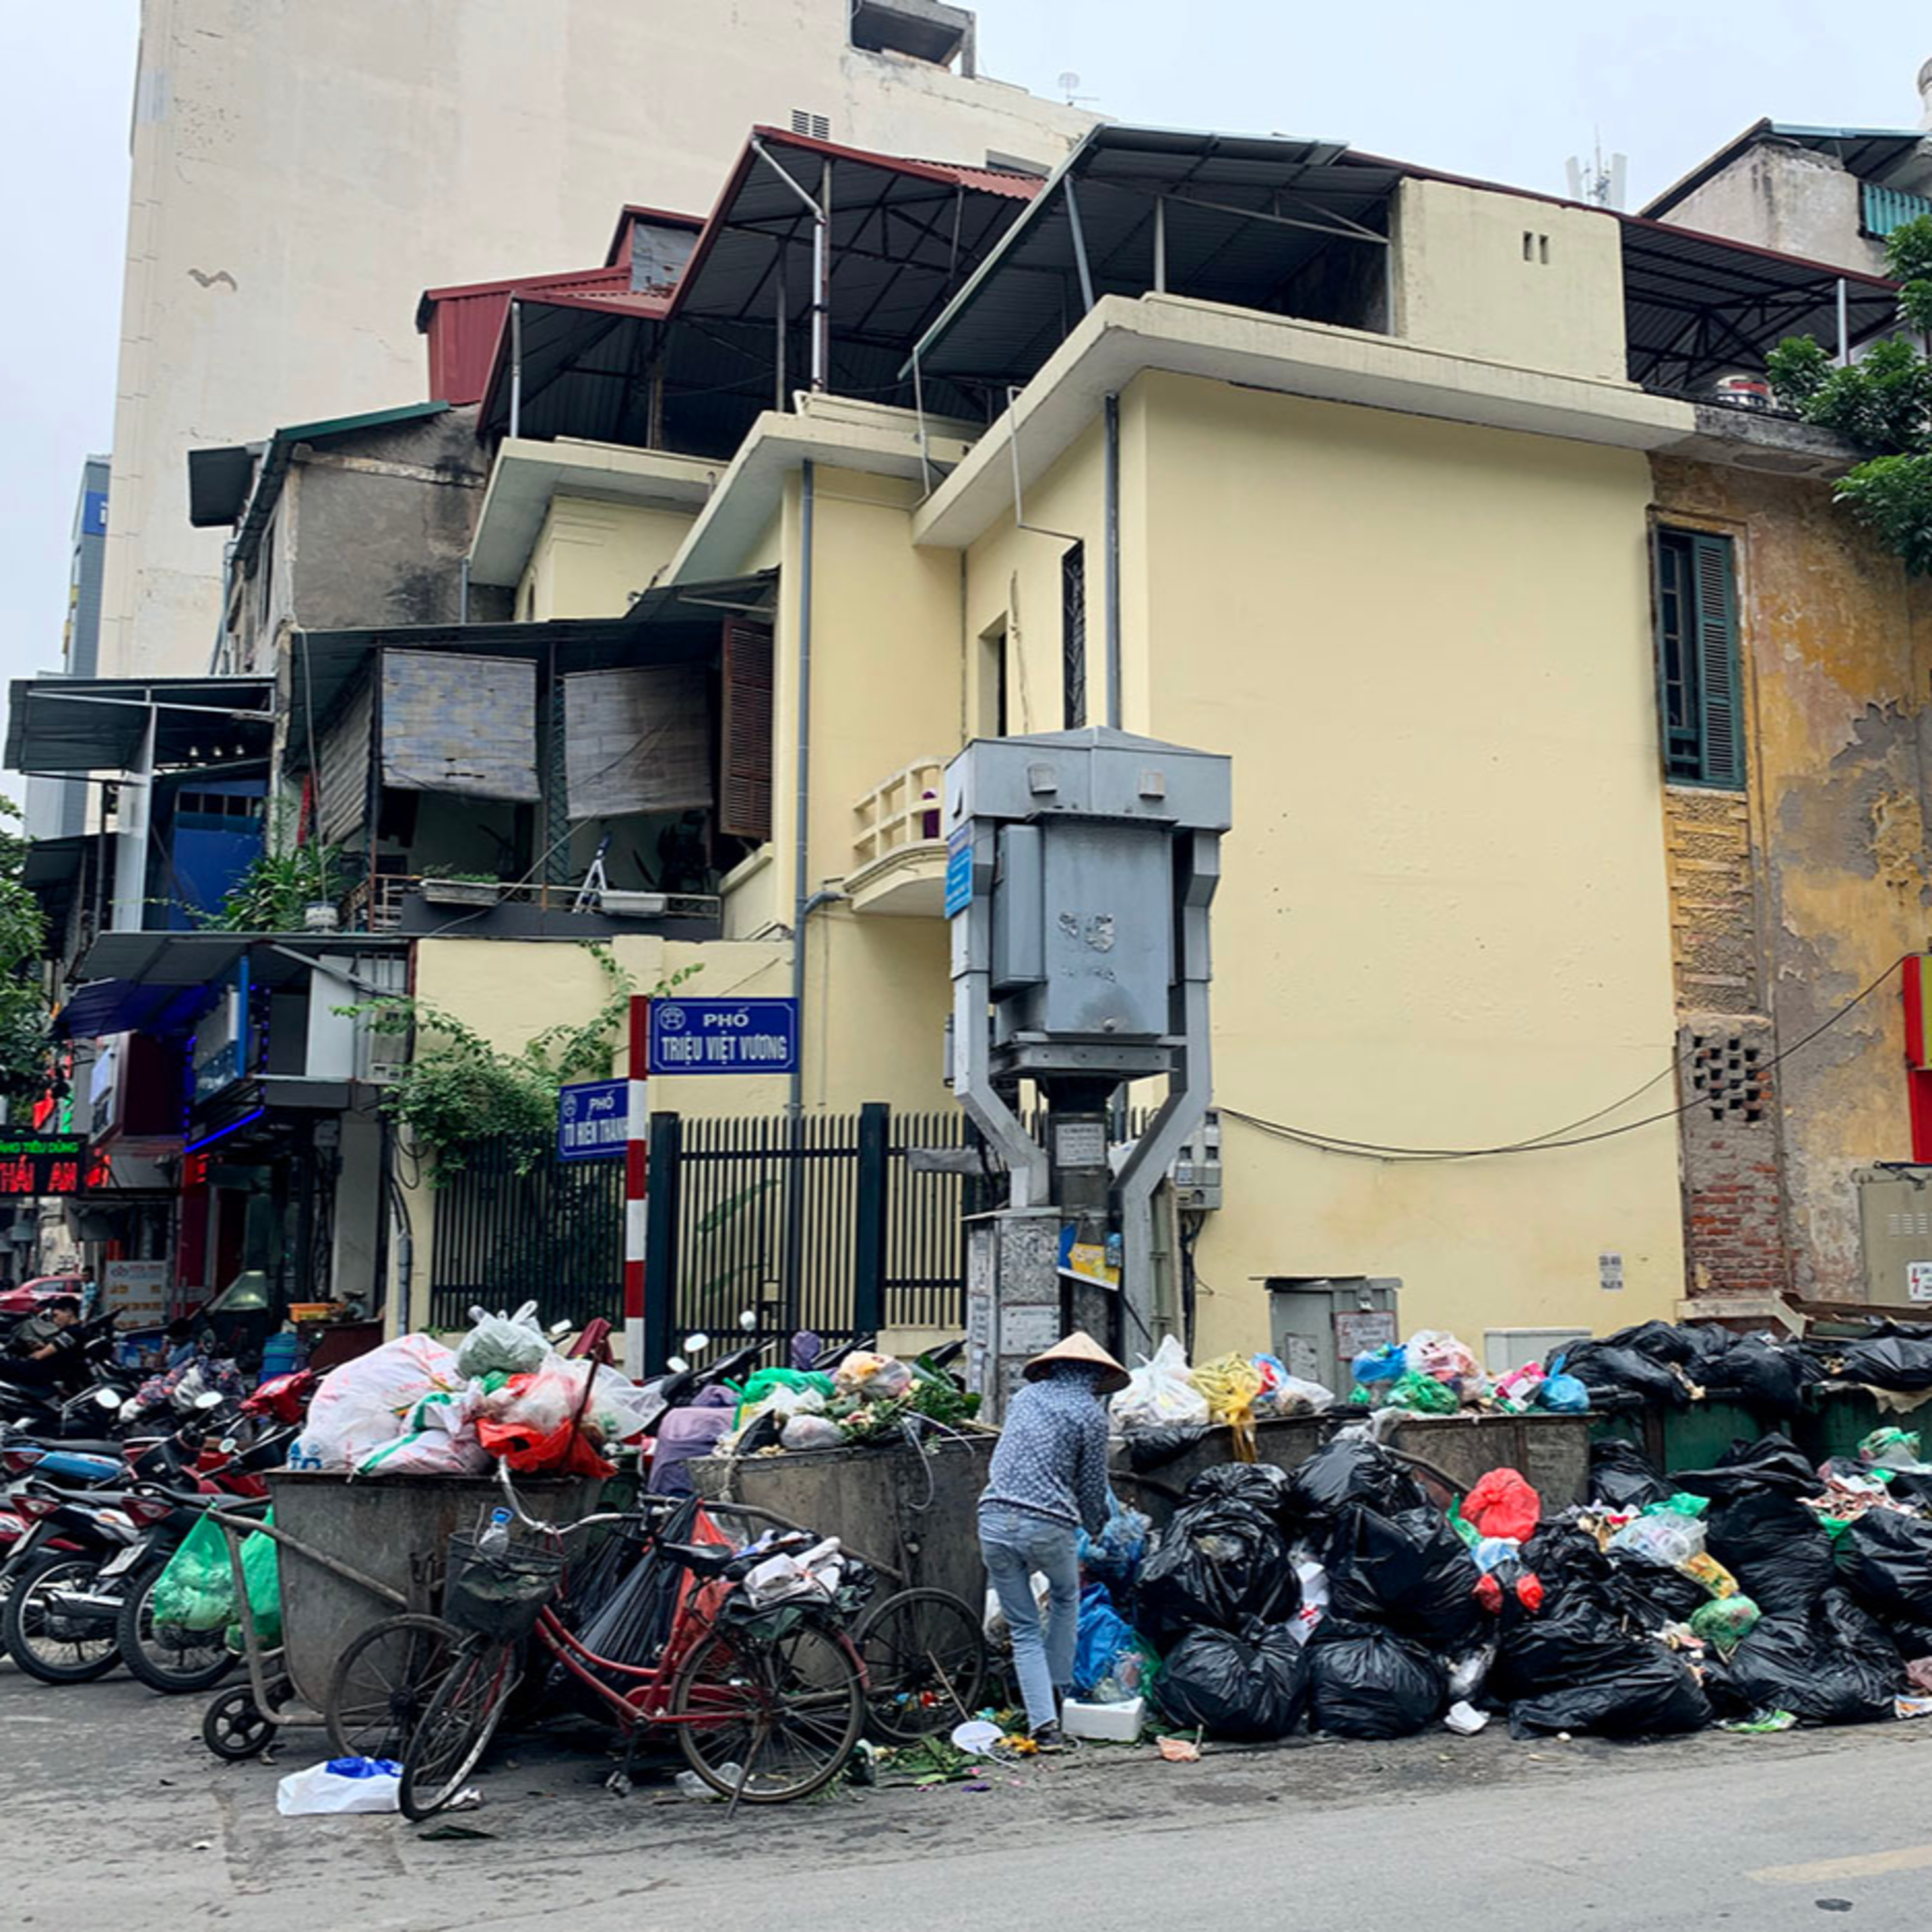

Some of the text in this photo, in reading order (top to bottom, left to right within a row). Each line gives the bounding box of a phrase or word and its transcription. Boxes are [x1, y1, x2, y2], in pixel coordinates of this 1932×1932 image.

[703, 1007, 750, 1027] PHỐ
[661, 1030, 703, 1066] TRIỆU
[706, 1030, 737, 1065] VIỆT
[589, 1089, 615, 1111] PHỐ
[47, 1162, 77, 1192] AN
